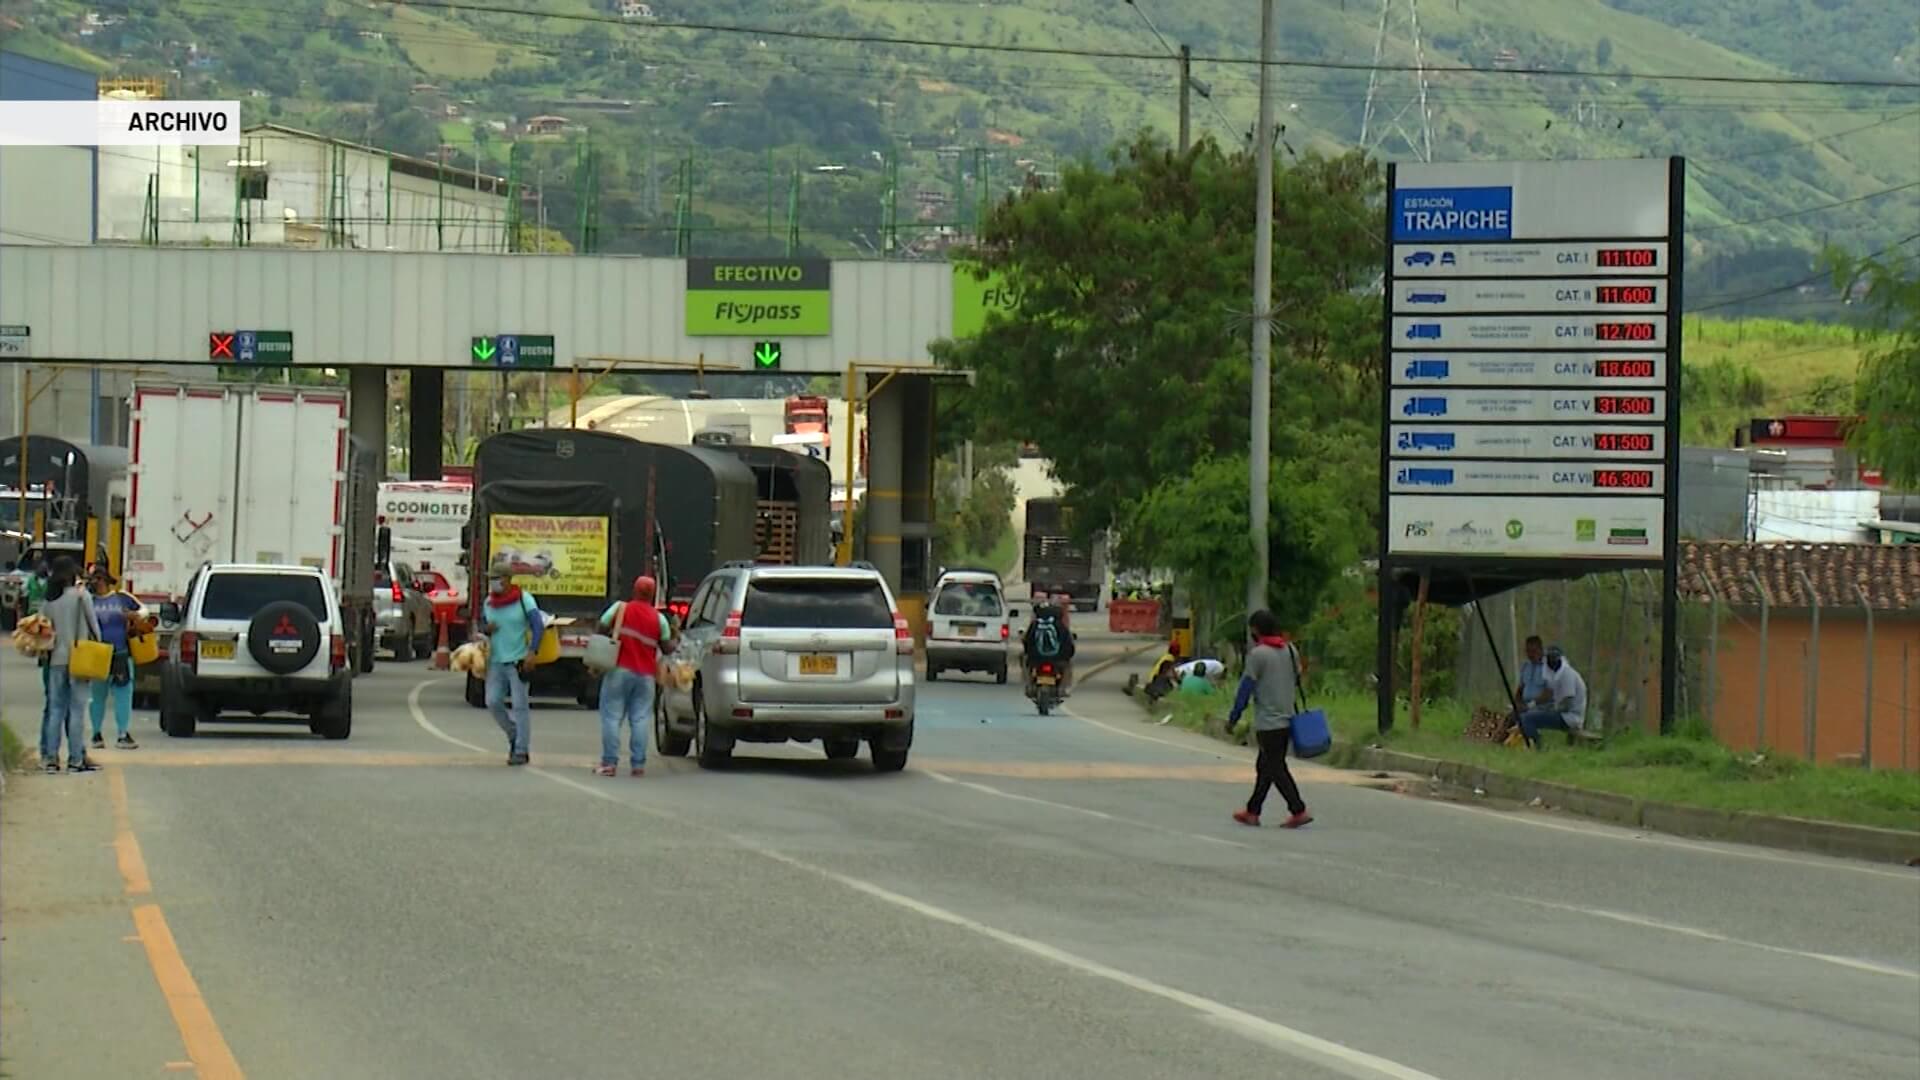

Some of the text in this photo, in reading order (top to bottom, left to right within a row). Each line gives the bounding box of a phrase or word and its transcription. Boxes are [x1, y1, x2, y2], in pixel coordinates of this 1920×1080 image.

[1404, 197, 1453, 208] ESTACIÓN
[1403, 209, 1508, 231] TRAPICHE
[1602, 251, 1652, 265] 11.100
[714, 266, 802, 281] EFECTIVO
[1601, 288, 1652, 302] 11.600
[715, 302, 802, 324] Flypass
[1601, 325, 1652, 339] 12.700
[1600, 361, 1651, 376] 18.600
[1599, 398, 1650, 413] 31.500
[1599, 435, 1650, 450] 41.500
[1599, 471, 1650, 486] 46.300
[386, 500, 468, 515] COONORTE
[494, 517, 602, 533] COMPRA VENTA
